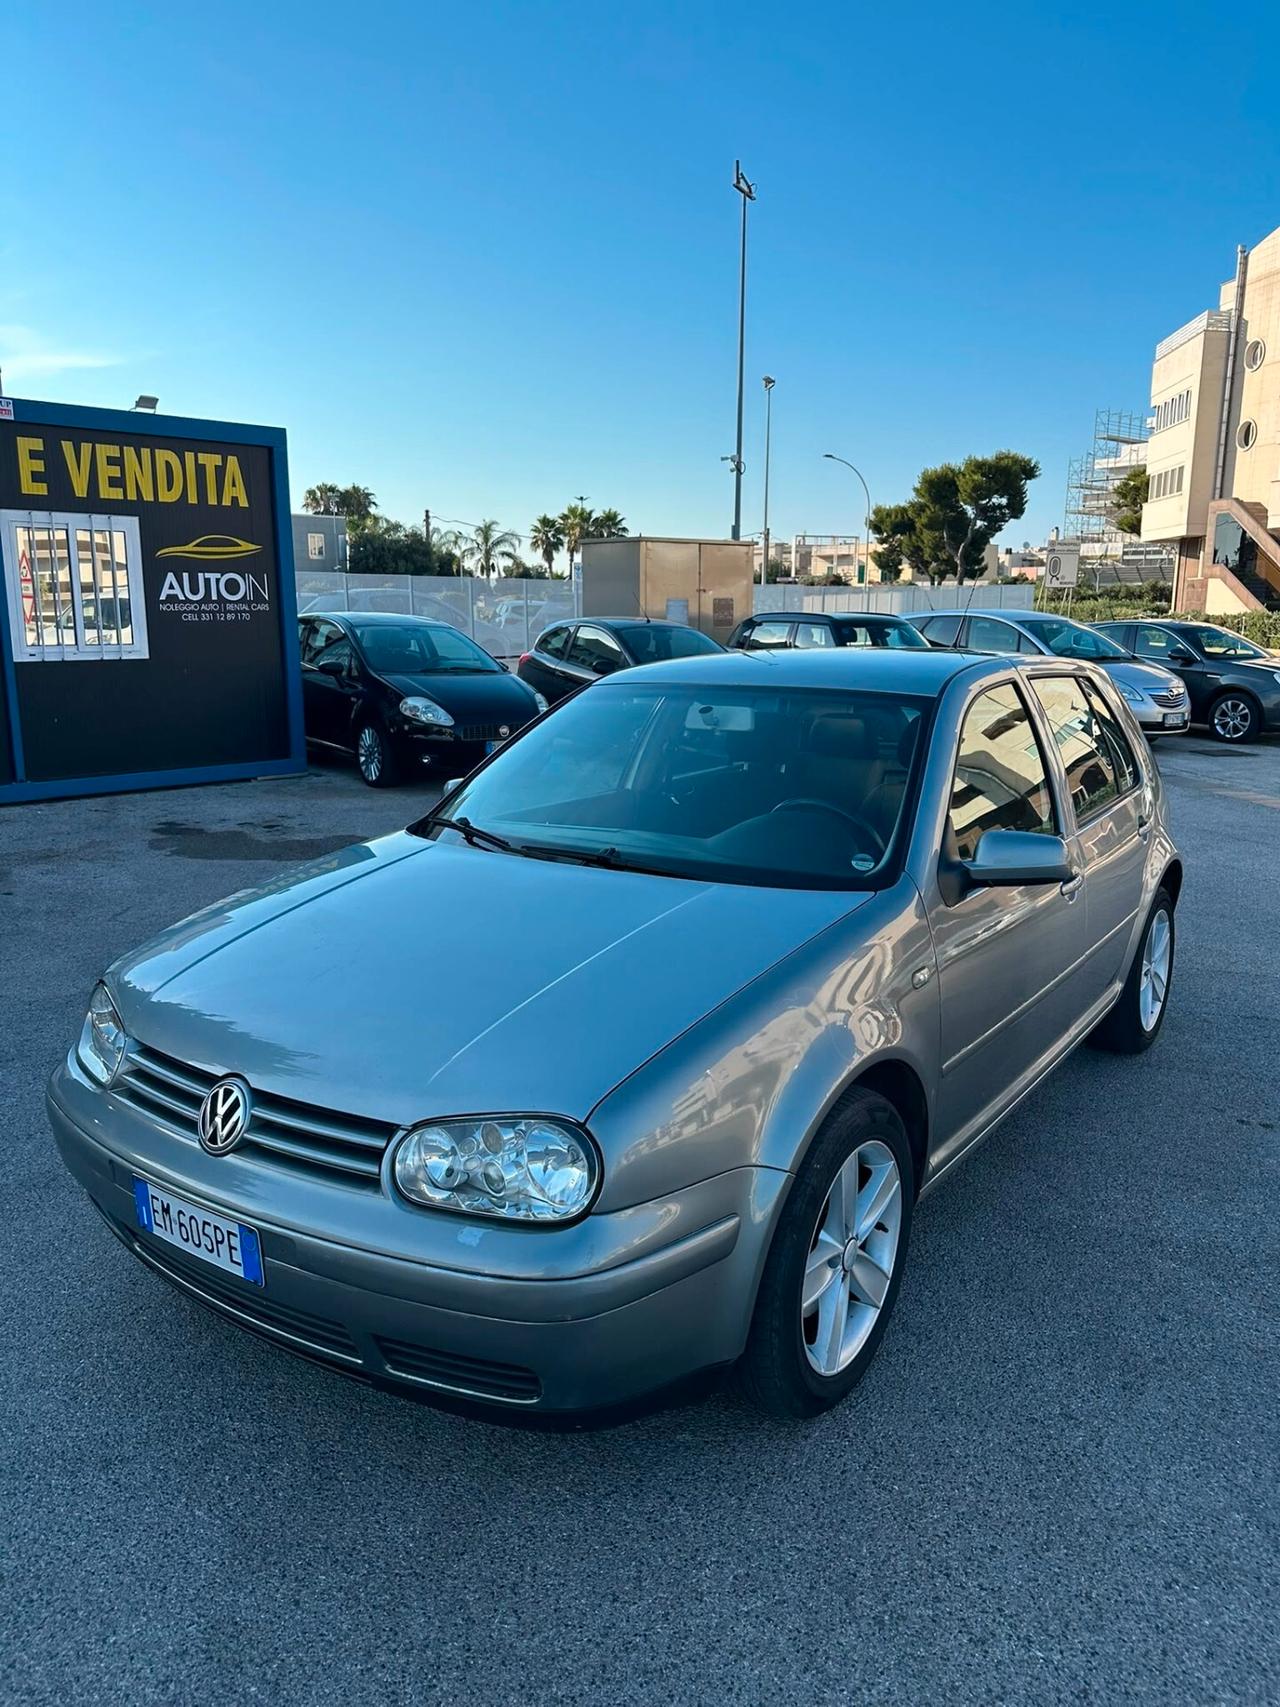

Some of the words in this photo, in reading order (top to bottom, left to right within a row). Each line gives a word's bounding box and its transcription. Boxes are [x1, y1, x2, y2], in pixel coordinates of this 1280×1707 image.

[16, 436, 48, 495] E
[61, 440, 249, 508] VENDITA
[159, 571, 269, 601] AUTOIN
[159, 603, 200, 612] NOLEGGIO
[200, 603, 220, 612] AUTO
[226, 603, 250, 612] RENTAL
[250, 603, 270, 612] CARS
[181, 613, 199, 621] CELL
[201, 613, 214, 621] 331
[216, 613, 225, 621] 12
[226, 613, 236, 621] 89
[237, 612, 251, 621] 170
